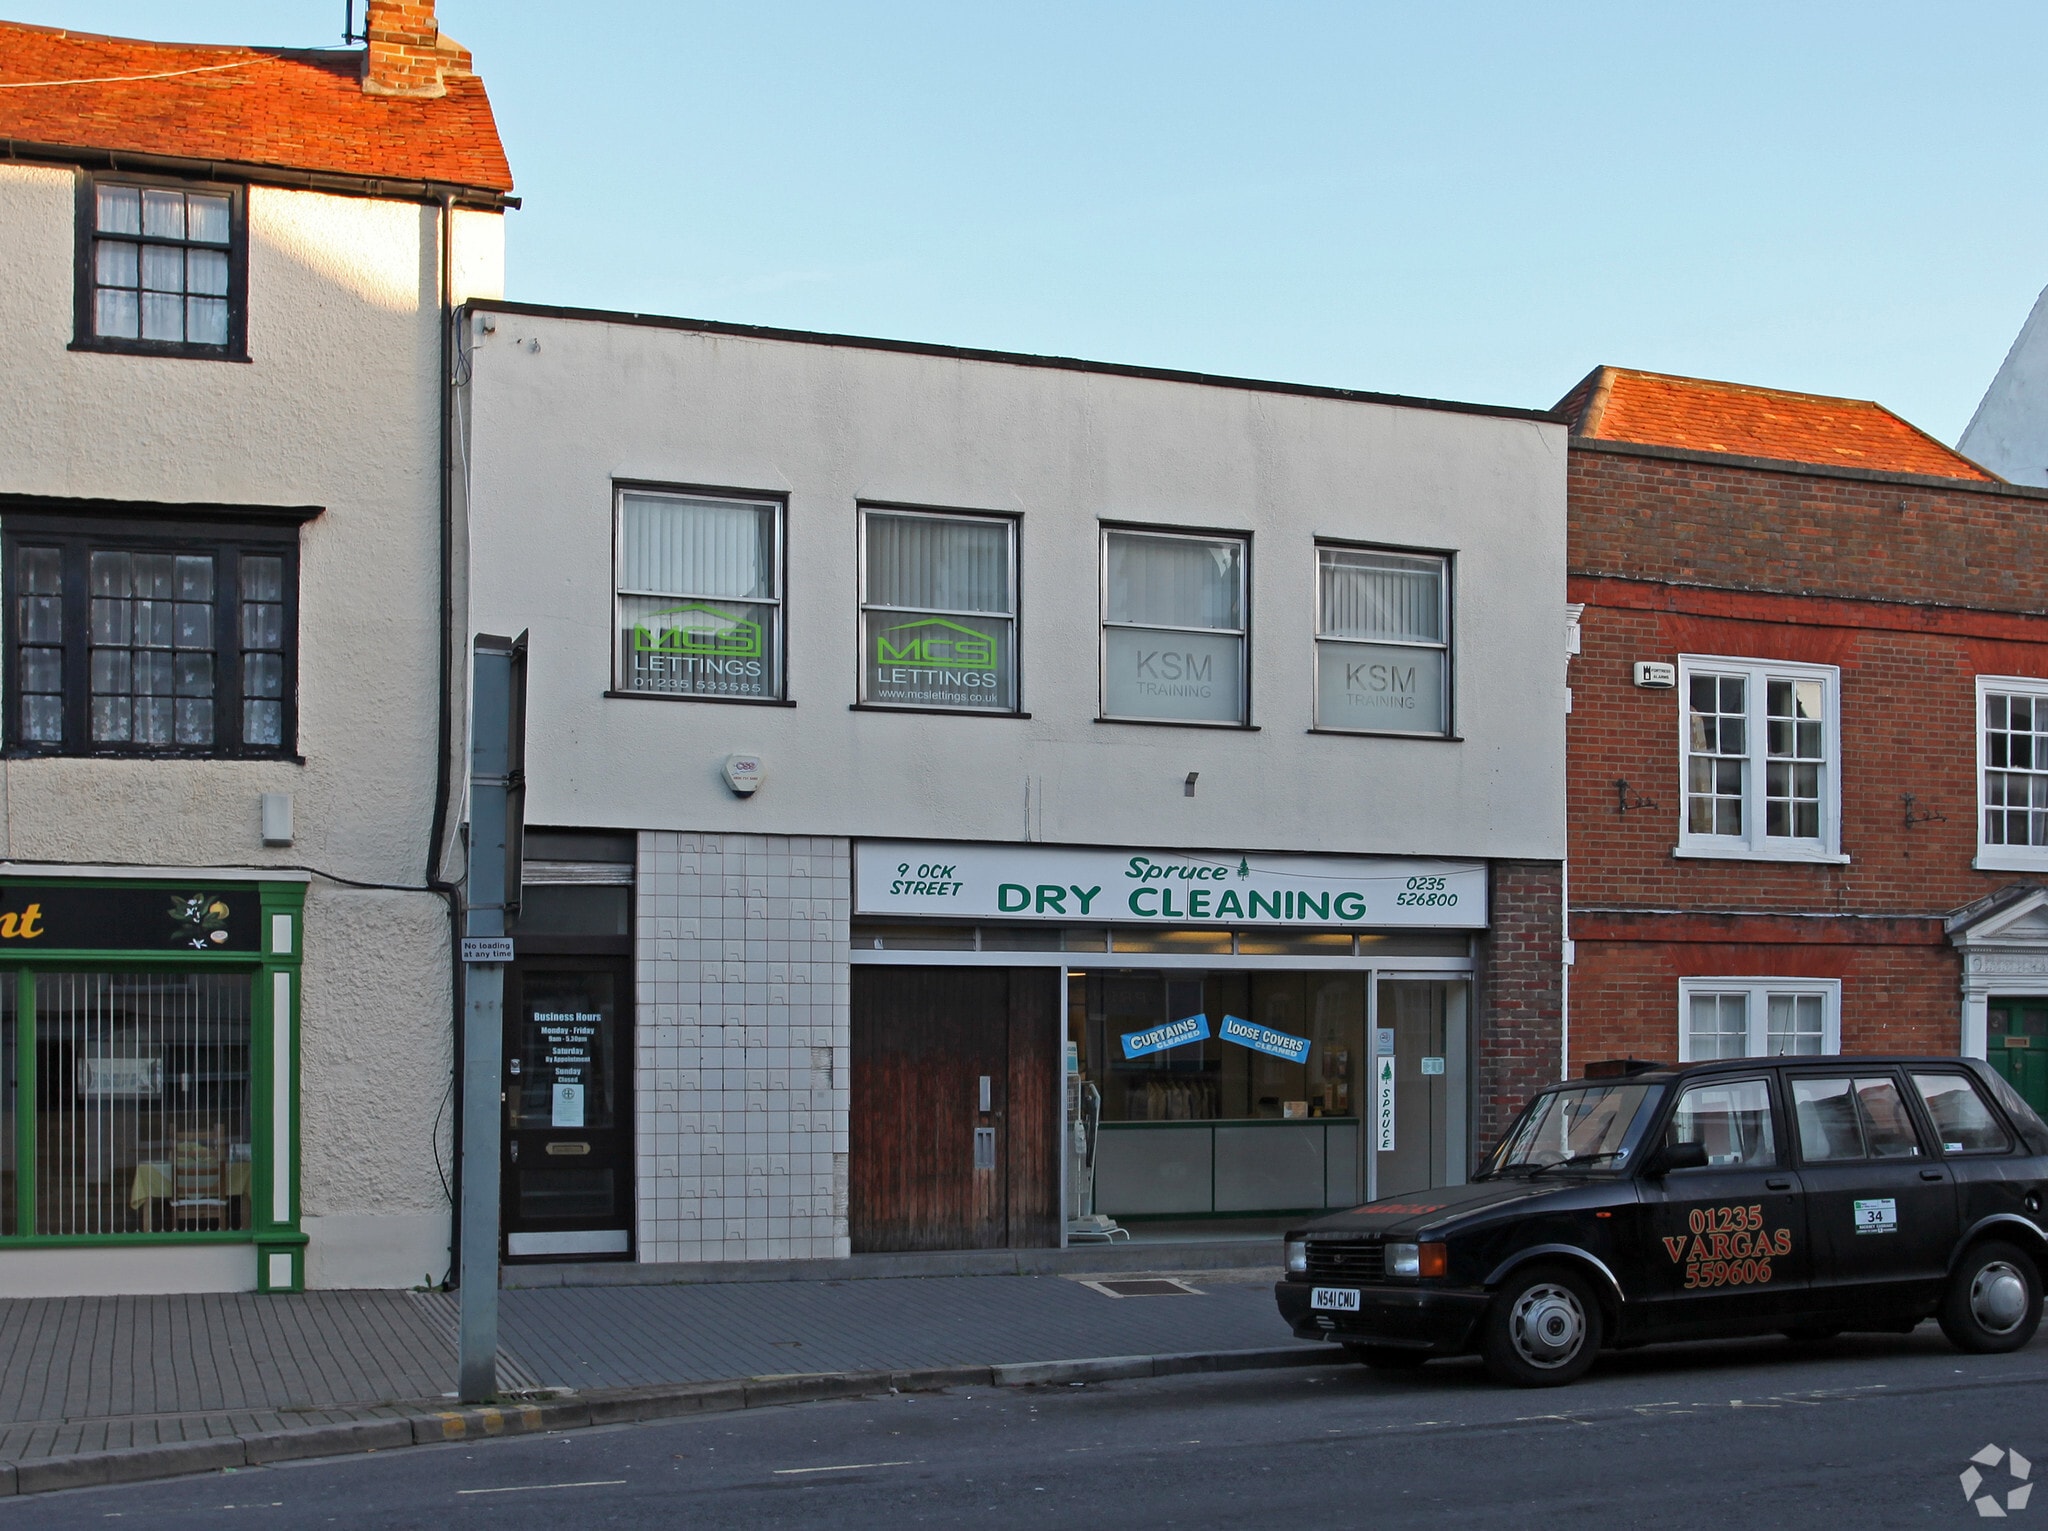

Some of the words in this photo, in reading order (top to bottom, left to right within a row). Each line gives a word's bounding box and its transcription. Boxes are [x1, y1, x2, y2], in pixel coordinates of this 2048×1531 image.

[634, 623, 755, 652] MCS
[877, 636, 990, 664] MCS
[634, 654, 761, 677] LETTINGS
[1136, 650, 1212, 682] KSM
[634, 677, 689, 689] 01235
[696, 680, 761, 692] 533585
[877, 667, 998, 688] LETTINGS
[1346, 663, 1416, 693] KSM
[878, 689, 998, 703] www.mcslettings.co.uk
[1136, 681, 1212, 699] TRAINING
[1346, 693, 1416, 710] TRAINING
[897, 863, 909, 878] 9
[917, 864, 957, 879] OCK
[1124, 856, 1228, 883] Spruce
[889, 880, 963, 896] STREET
[1406, 876, 1446, 891] 0235
[997, 883, 1102, 916] DRY
[1127, 886, 1367, 921] CLEANING
[1396, 892, 1458, 907] 526800
[464, 942, 477, 950] No
[479, 942, 510, 950] loading
[493, 950, 512, 958] time
[534, 1012, 575, 1022] Business
[575, 1012, 602, 1022] Hours
[541, 1026, 569, 1035] Monday
[573, 1026, 595, 1035] Friday
[1130, 1018, 1198, 1051] CURTAINS
[1226, 1019, 1260, 1042] LOOSE
[1262, 1030, 1304, 1052] COVERS
[1156, 1030, 1200, 1050] CLEANED
[552, 1047, 584, 1055] Saturday
[1255, 1041, 1298, 1058] CLEANED
[555, 1067, 581, 1075] Sunday
[1382, 1088, 1391, 1149] SPRUCE
[1688, 1204, 1763, 1234] 01235
[1867, 1211, 1883, 1223] 34
[1662, 1228, 1792, 1264] VARGAS
[1684, 1257, 1772, 1289] 559606
[1316, 1290, 1337, 1308] N541
[1337, 1291, 1356, 1308] CMU
